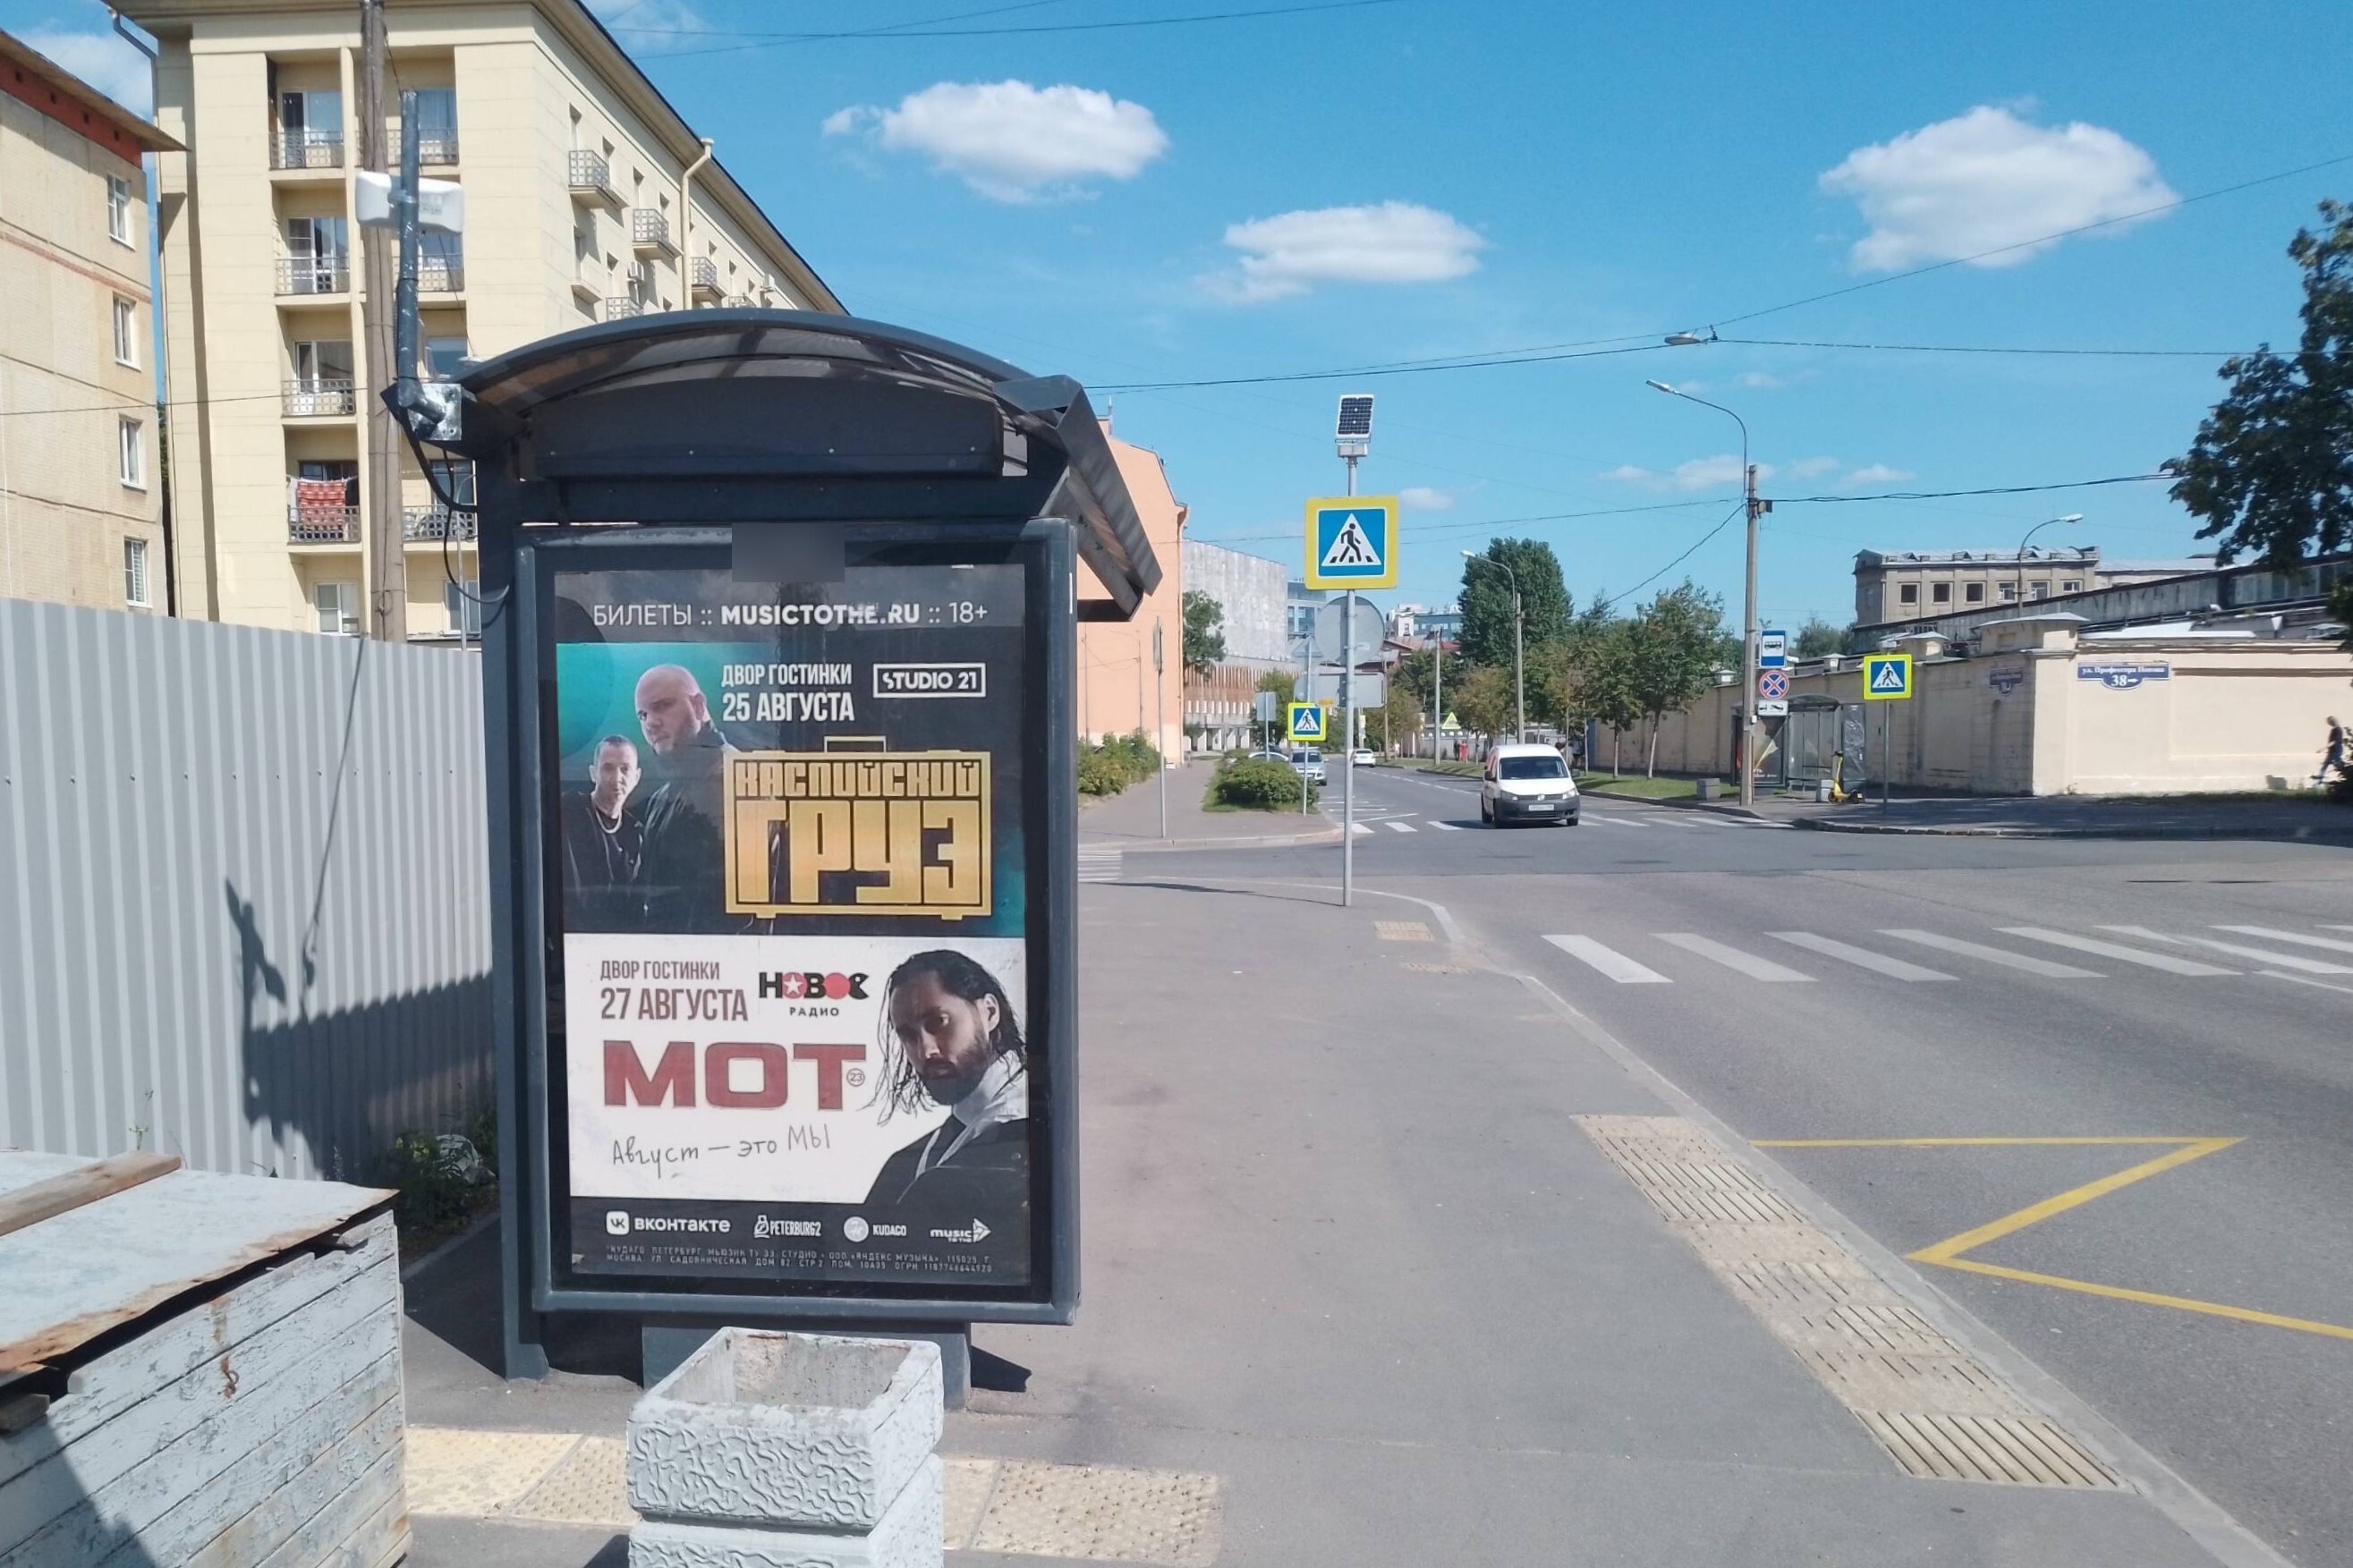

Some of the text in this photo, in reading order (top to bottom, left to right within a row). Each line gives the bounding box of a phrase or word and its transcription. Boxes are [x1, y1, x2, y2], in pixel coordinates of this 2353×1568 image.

[593, 604, 692, 625] БИЛЕТЫ
[721, 604, 920, 625] MUSICTOTHE.RU
[948, 602, 988, 623] 18+
[720, 664, 852, 687] ДВОР ГОСТИНКИ
[881, 671, 977, 691] STUDIO 21
[2111, 674, 2128, 686] 38
[722, 691, 854, 722] 25 АВГУСТА
[739, 760, 980, 797] КАСПИЙСКИЙ
[736, 800, 981, 904] ГРУЗ
[599, 960, 720, 981] ДВОР ГОСТИНКИ
[600, 987, 749, 1021] 27 АВГУСТА
[789, 1006, 840, 1019] РАДИО
[603, 1039, 867, 1111] МОТ
[849, 1072, 864, 1083] 23
[612, 1135, 700, 1179] Август
[737, 1140, 777, 1157] это
[787, 1123, 830, 1151] МЫ
[769, 1221, 821, 1236] PETERBURG2
[872, 1224, 907, 1236] KUDAGO
